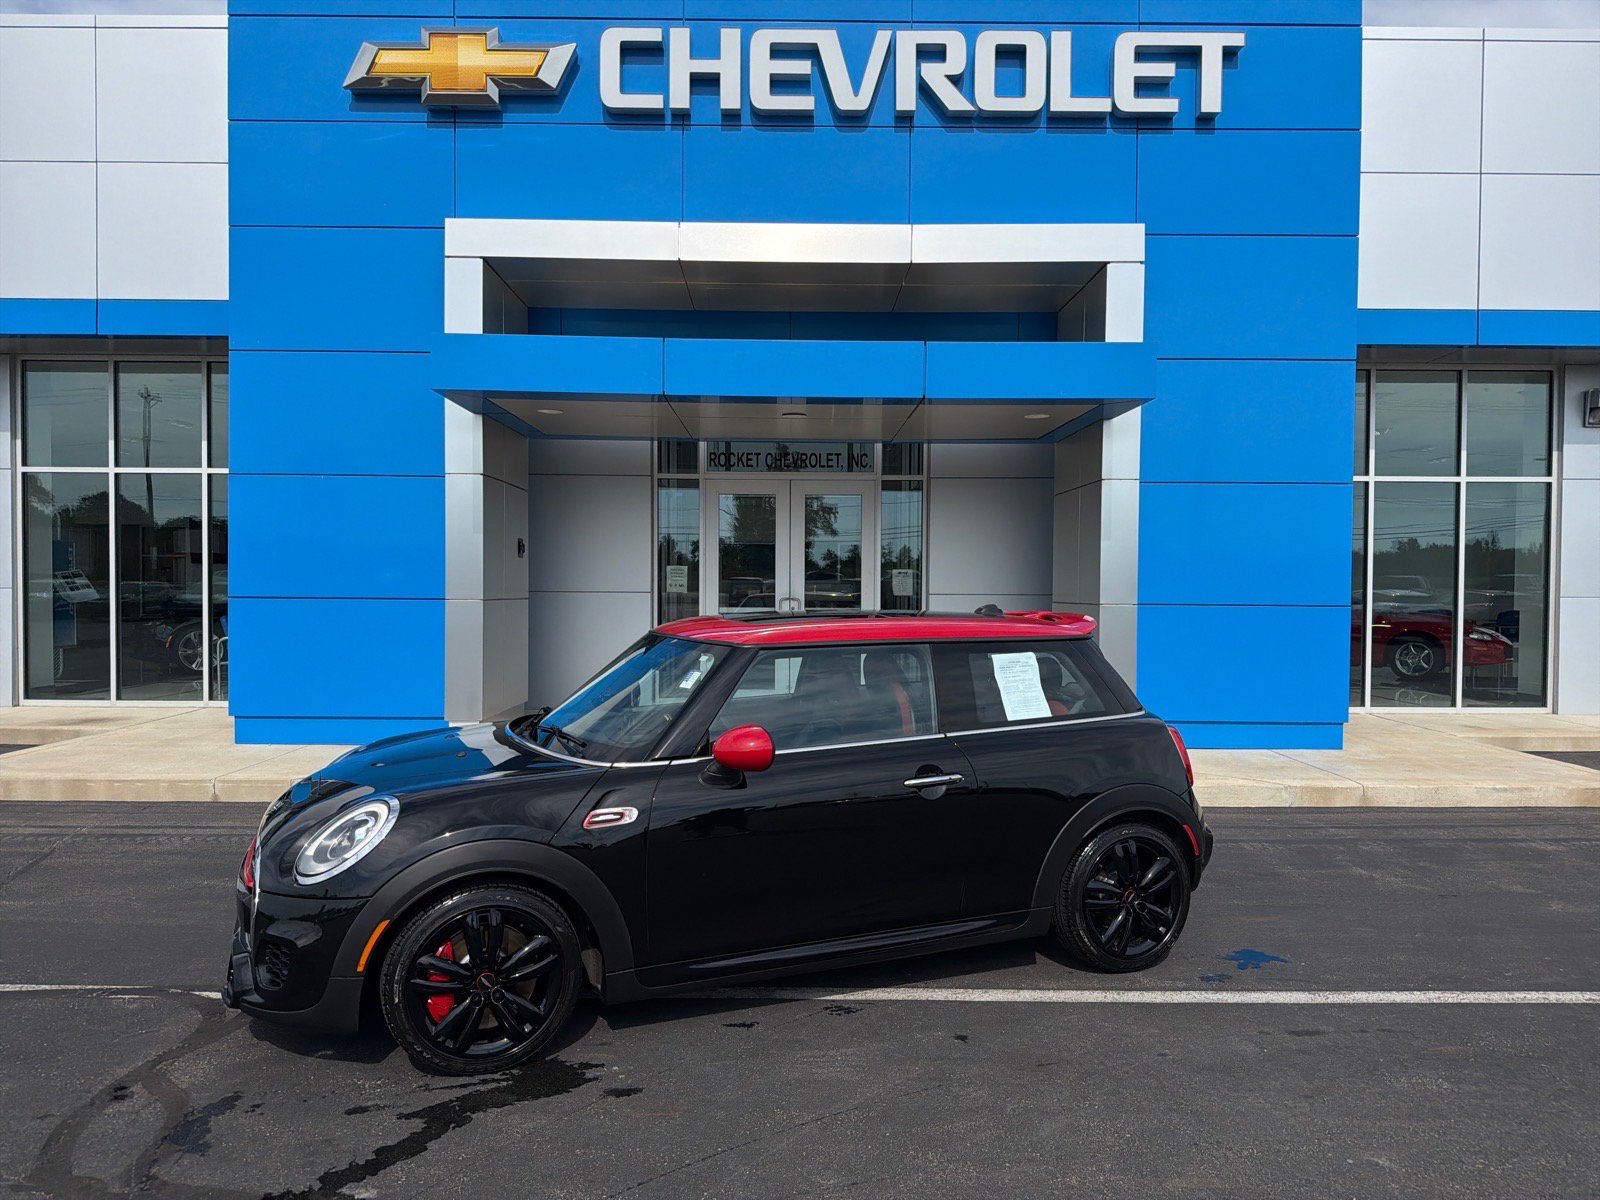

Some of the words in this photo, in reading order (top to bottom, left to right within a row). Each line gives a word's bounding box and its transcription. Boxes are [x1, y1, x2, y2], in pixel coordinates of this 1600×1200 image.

[600, 26, 1246, 118] CHEVROLET
[709, 452, 761, 468] ROCKET
[765, 452, 844, 471] CHEVROLET,
[847, 452, 872, 469] INC.
